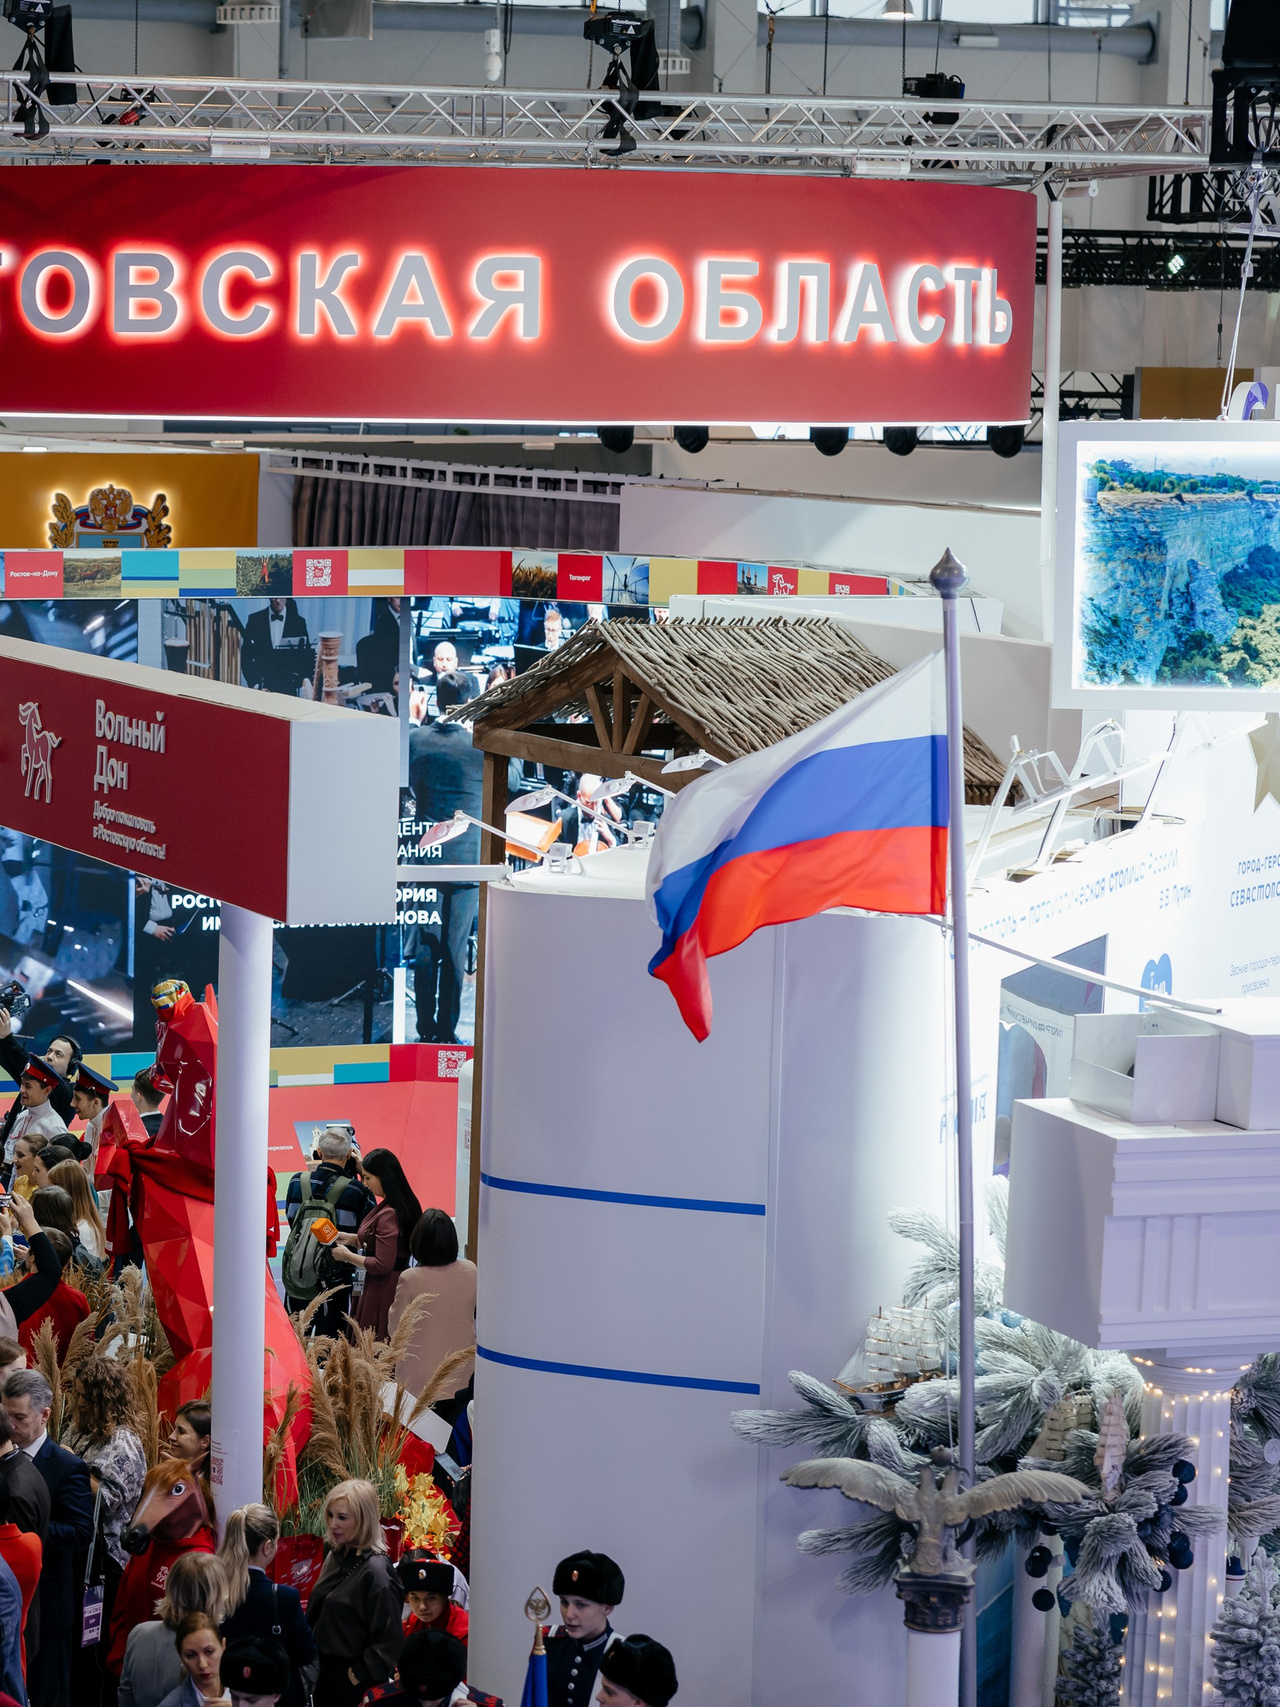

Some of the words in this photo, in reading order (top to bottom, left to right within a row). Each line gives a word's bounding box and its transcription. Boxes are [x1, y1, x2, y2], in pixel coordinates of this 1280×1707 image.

[612, 257, 1014, 346] ОБЛАСТЬ
[9, 569, 59, 578] Ростов-на-Дону
[95, 699, 166, 754] Вольный
[93, 744, 129, 795] Дон
[93, 800, 116, 824] Добро
[115, 810, 157, 834] пожаловать
[397, 821, 439, 838] ЕНТ
[98, 824, 137, 854] Ростовскую
